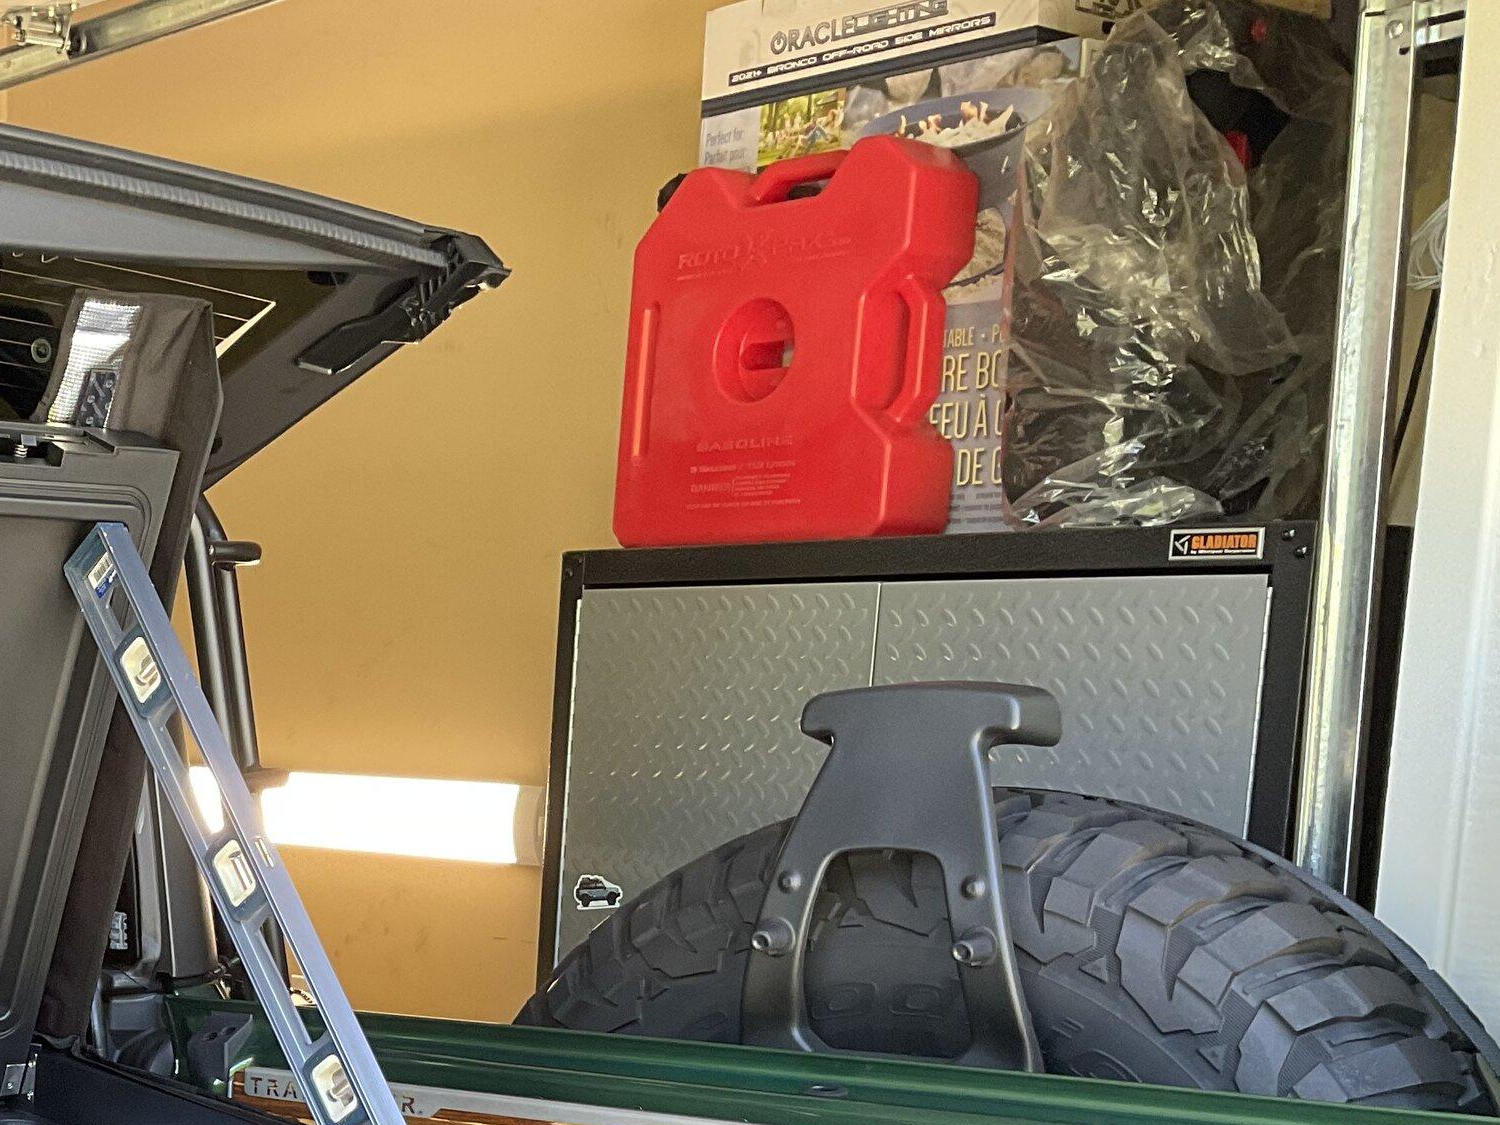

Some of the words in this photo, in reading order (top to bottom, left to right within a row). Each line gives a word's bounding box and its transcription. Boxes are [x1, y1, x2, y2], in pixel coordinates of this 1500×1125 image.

[766, 57, 818, 75] BRONCO
[822, 39, 890, 62] OFF-ROAD
[894, 31, 924, 45] SIDE
[928, 15, 992, 38] MIRRORS
[1191, 533, 1257, 550] GLADIATOR
